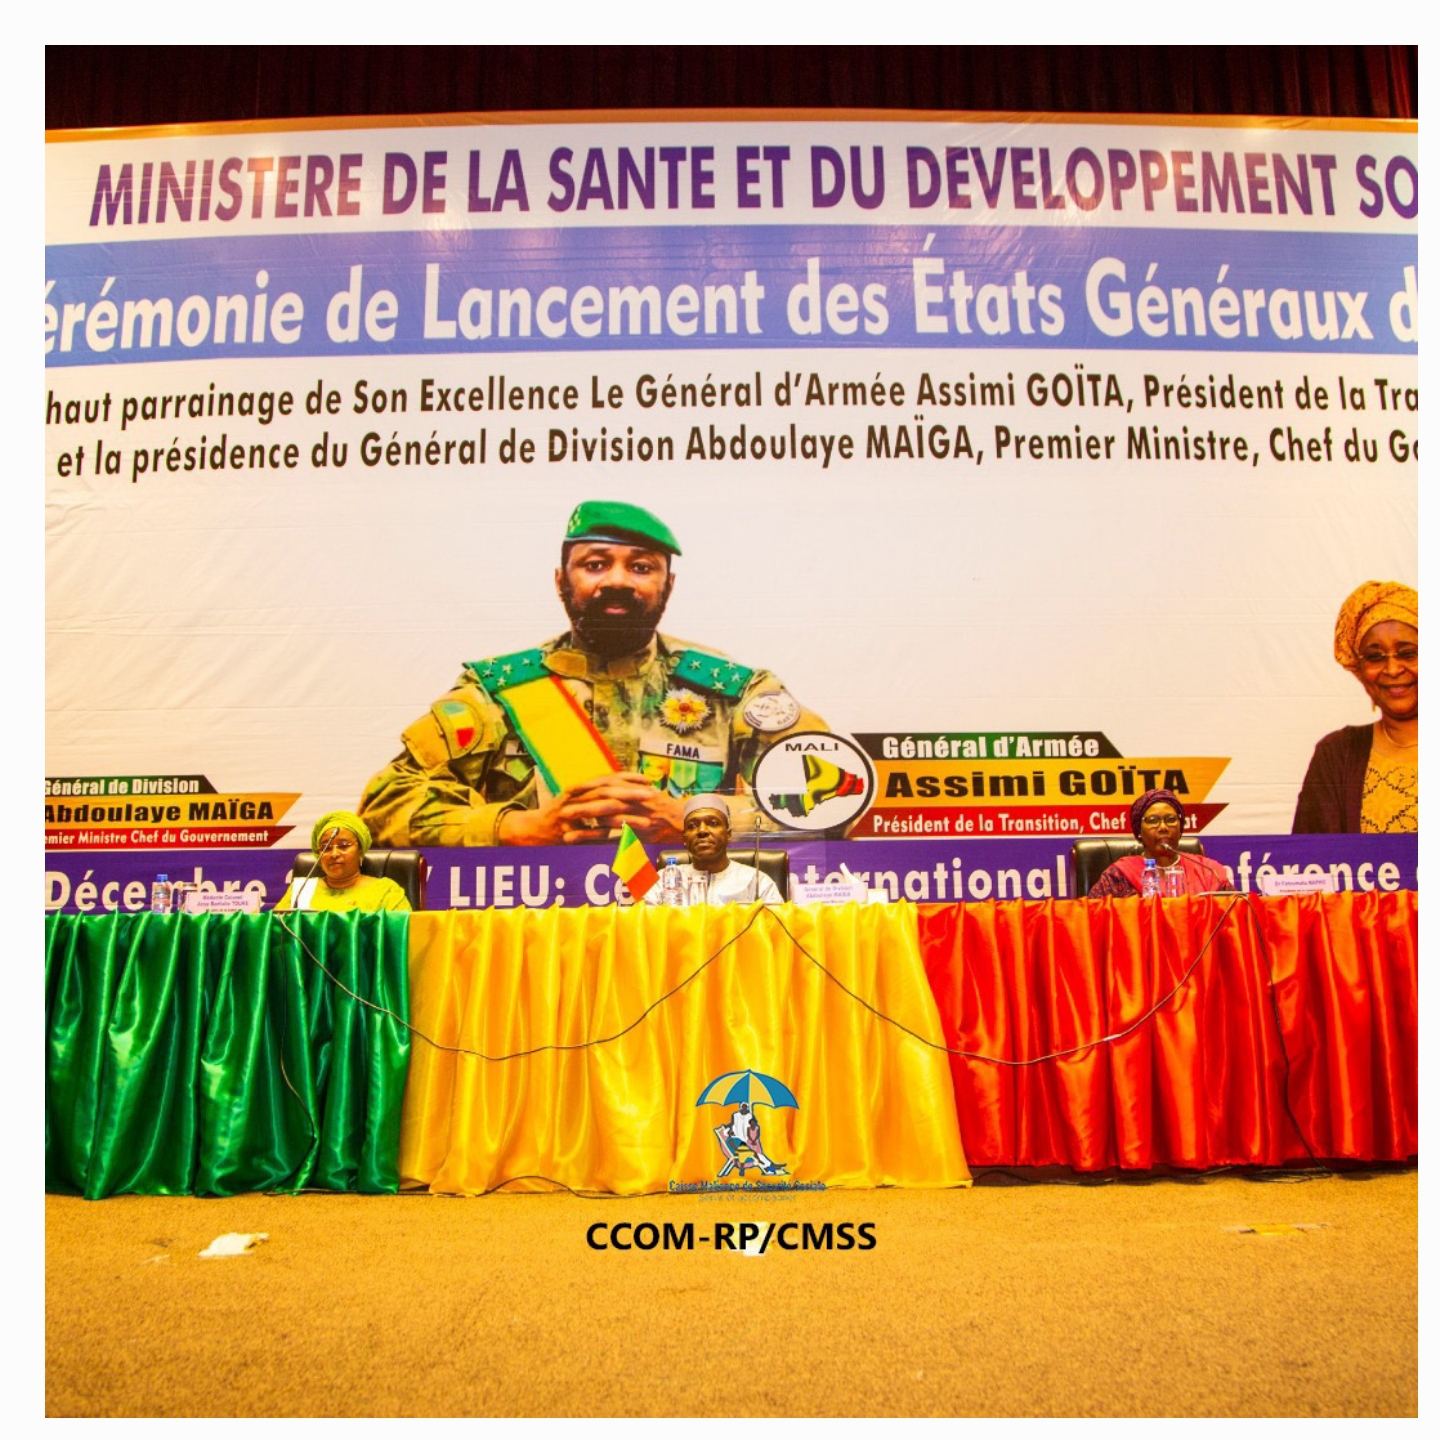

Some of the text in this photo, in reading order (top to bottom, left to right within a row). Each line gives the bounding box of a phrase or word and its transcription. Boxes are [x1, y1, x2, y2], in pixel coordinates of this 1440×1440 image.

[89, 153, 364, 227] MINISTERE
[382, 150, 448, 216] DE
[467, 148, 530, 214] LA
[547, 146, 716, 213] SANTE
[736, 145, 790, 209] ET
[810, 145, 885, 209] DU
[907, 146, 1337, 216] DEVELOPPEMENT
[326, 264, 399, 345] de
[423, 263, 764, 341] Lancement
[787, 258, 889, 336] des
[914, 232, 1066, 337] États
[1085, 257, 1374, 341] Généraux
[45, 390, 112, 425] haut
[121, 383, 294, 430] parrainage
[305, 379, 342, 415] de
[353, 379, 408, 414] Son
[419, 376, 579, 412] Excellence
[590, 375, 624, 409] Le
[634, 372, 762, 408] Général
[917, 371, 1015, 407] Assimi
[1026, 364, 1134, 413] GOÏTA,
[1143, 376, 1284, 410] Président
[1295, 376, 1329, 411] de
[1338, 376, 1366, 411] la
[1374, 378, 1418, 412] Tra
[57, 414, 1418, 483] et la présidence du Général de Division Abdoulaye MAÏGA, Premier Ministre, Chef du G
[666, 742, 700, 759] FAMA
[785, 742, 839, 752] MALI
[883, 736, 987, 759] Général
[45, 777, 200, 796] Général de Division
[885, 765, 1190, 798] Assimi GOÏTA
[45, 798, 274, 823] Abdoulaye MAÏGA
[873, 814, 949, 833] Président
[953, 814, 976, 832] de
[980, 814, 993, 832] la
[998, 813, 1084, 833] Transition,
[1089, 811, 1127, 830] Chef
[78, 831, 127, 844] Ministre
[130, 830, 159, 843] Chef
[161, 829, 176, 843] du
[180, 829, 269, 842] Gouvernement
[450, 864, 565, 907] LIEU:
